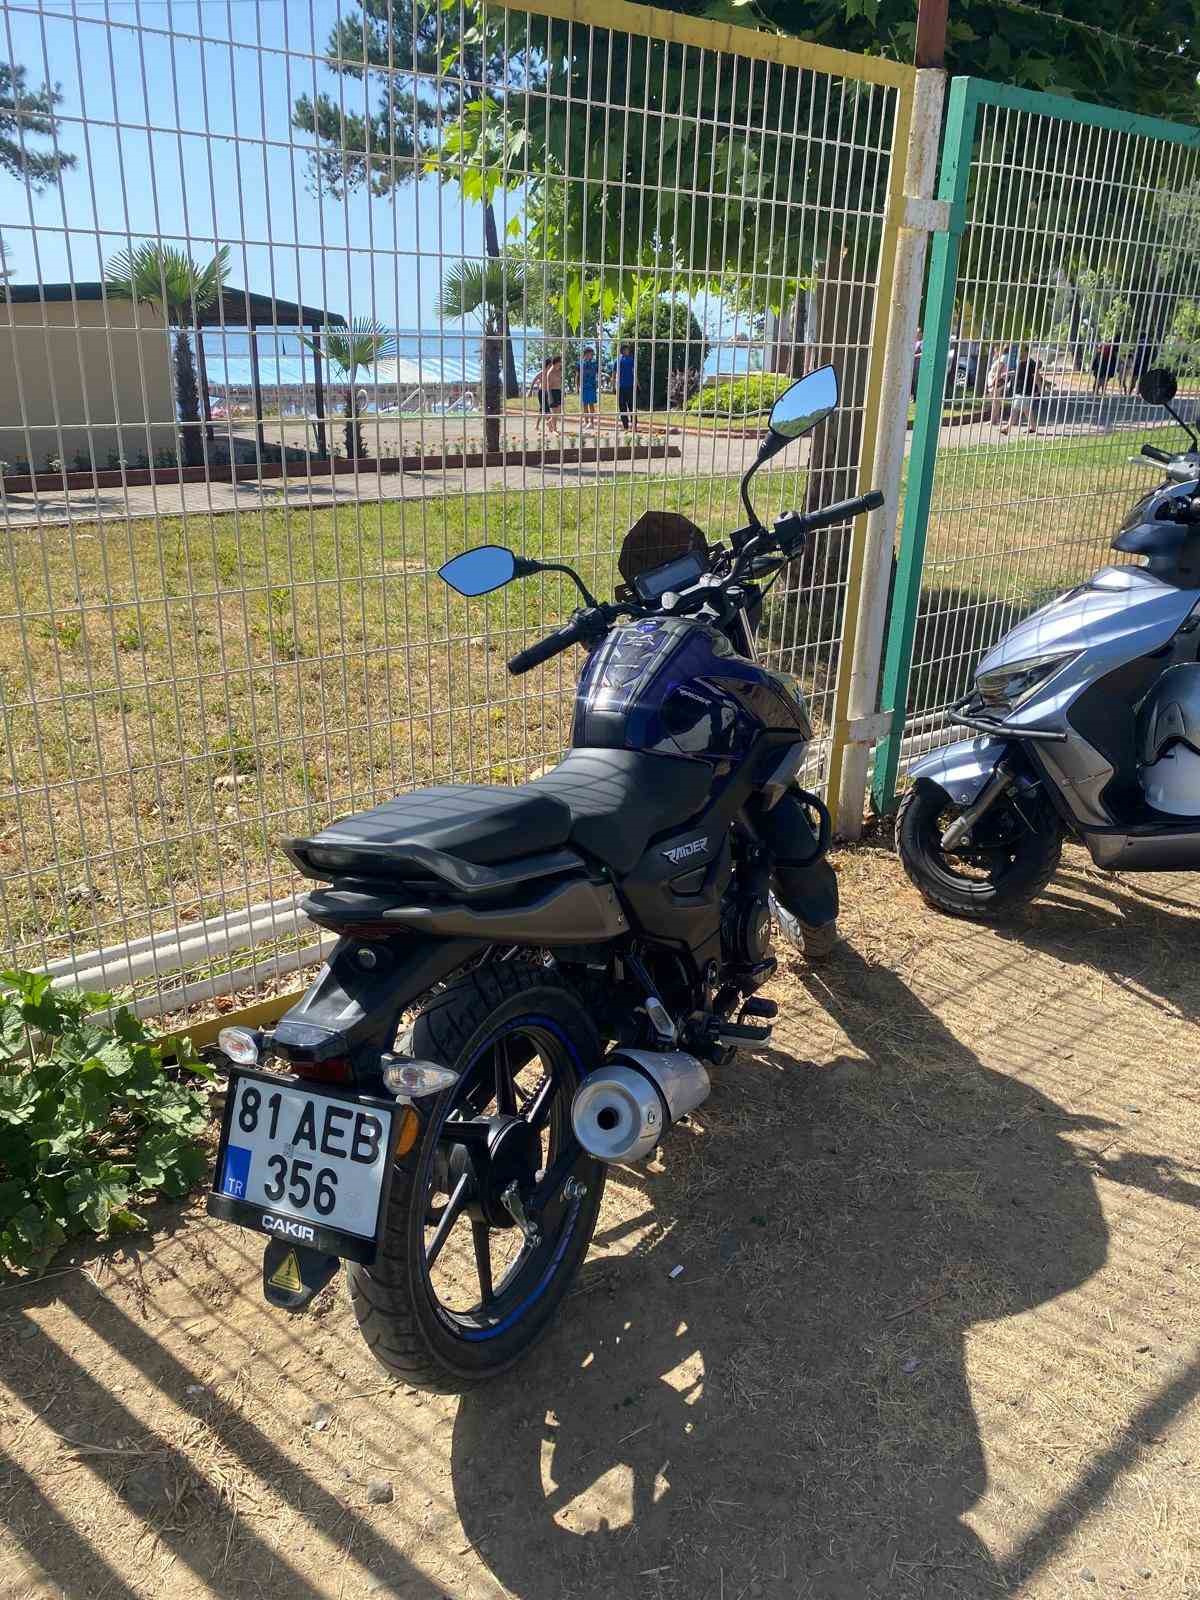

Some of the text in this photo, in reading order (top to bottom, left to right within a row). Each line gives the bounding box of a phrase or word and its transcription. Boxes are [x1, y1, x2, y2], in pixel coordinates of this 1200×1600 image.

[662, 837, 709, 865] RAIDER
[239, 1086, 383, 1165] 81 AEB
[228, 1177, 243, 1195] TR
[264, 1154, 338, 1216] 356
